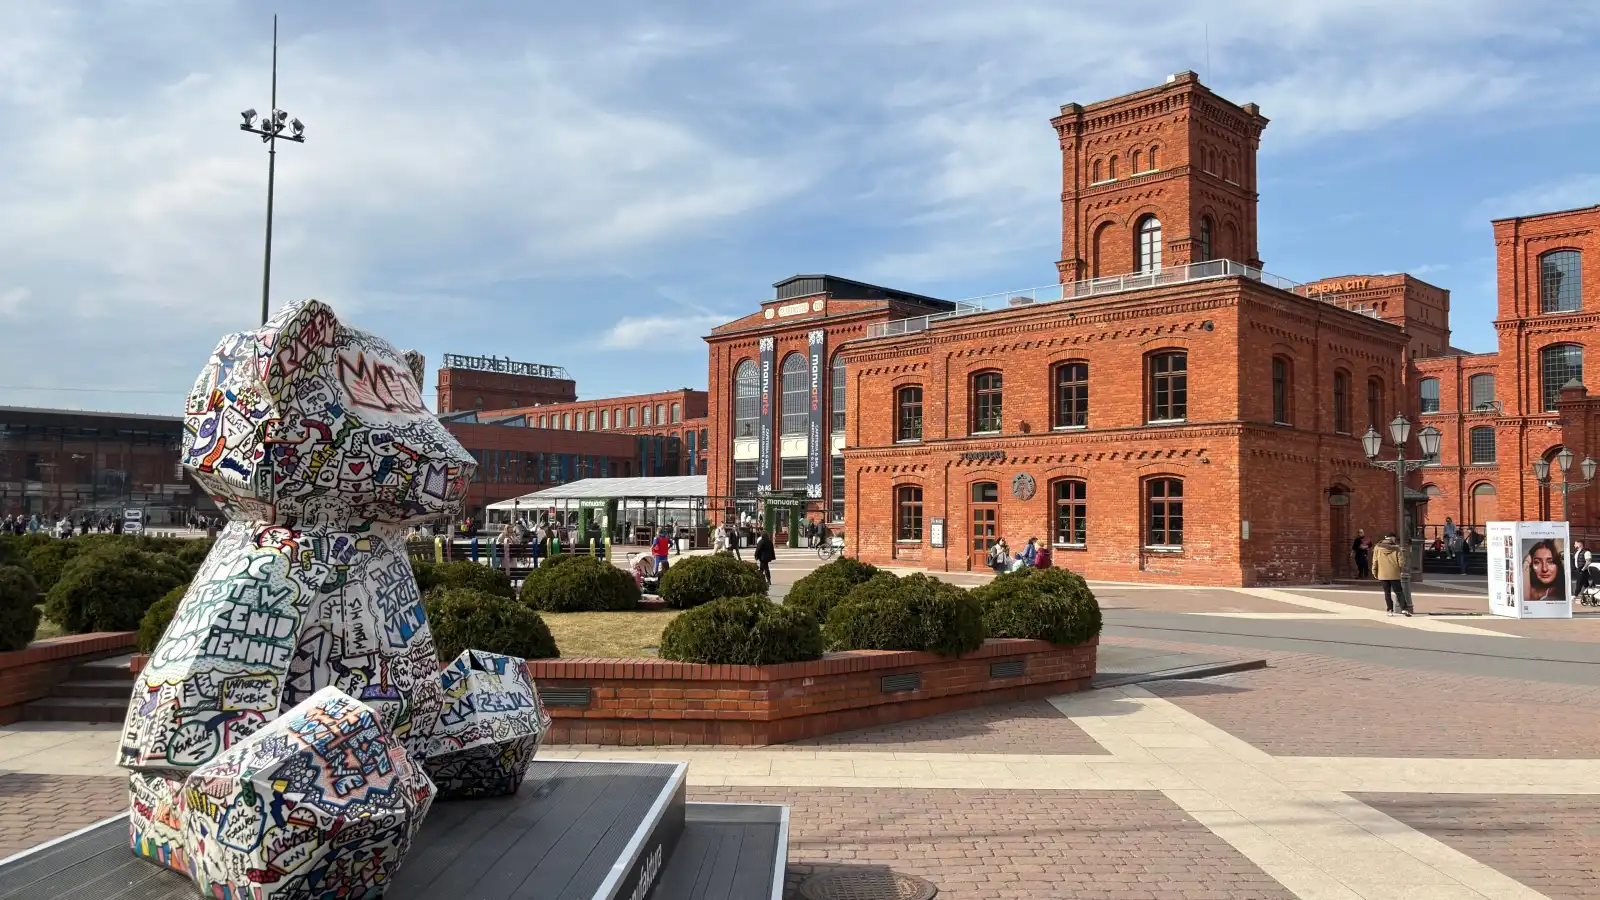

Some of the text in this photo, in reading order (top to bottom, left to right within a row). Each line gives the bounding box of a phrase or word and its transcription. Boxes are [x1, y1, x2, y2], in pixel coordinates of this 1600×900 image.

[1307, 279, 1368, 294] CINEMA CITY
[762, 361, 770, 416] manuarte
[811, 354, 819, 411] manuarte
[767, 498, 799, 506] manuarte
[210, 554, 276, 581] MOC
[186, 578, 293, 613] JEST W
